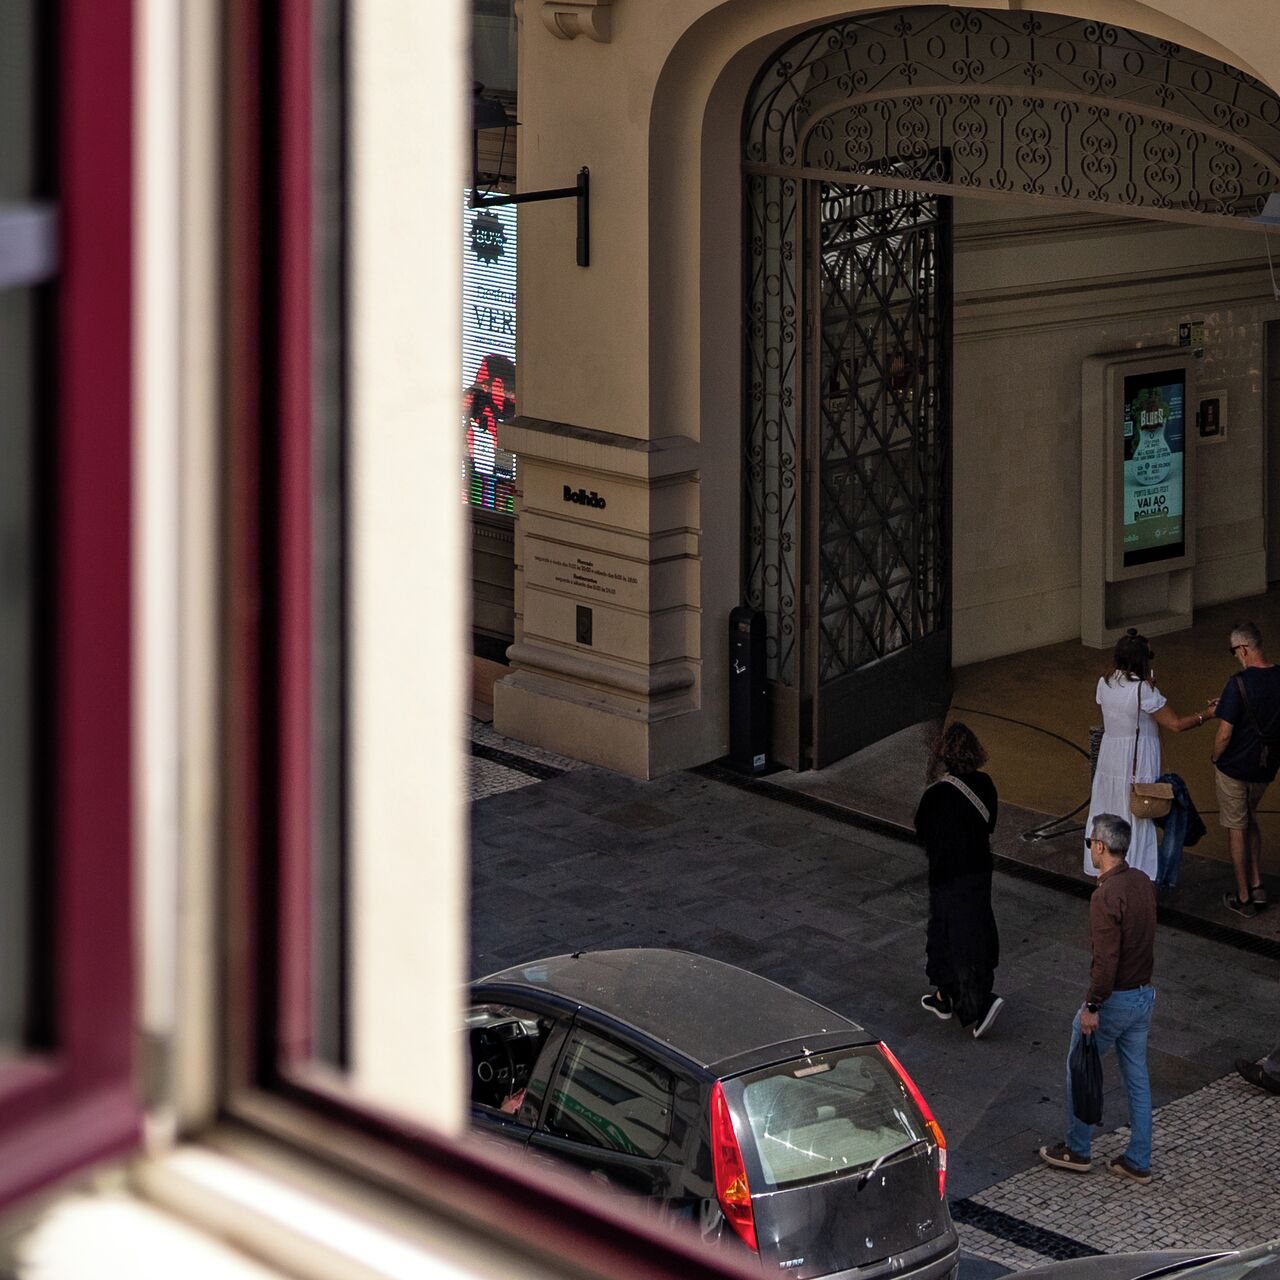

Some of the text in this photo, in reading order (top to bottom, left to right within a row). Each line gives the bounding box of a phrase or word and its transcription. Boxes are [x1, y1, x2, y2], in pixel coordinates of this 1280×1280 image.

[563, 484, 607, 510] Bolhão
[1137, 495, 1166, 508] VAI AO
